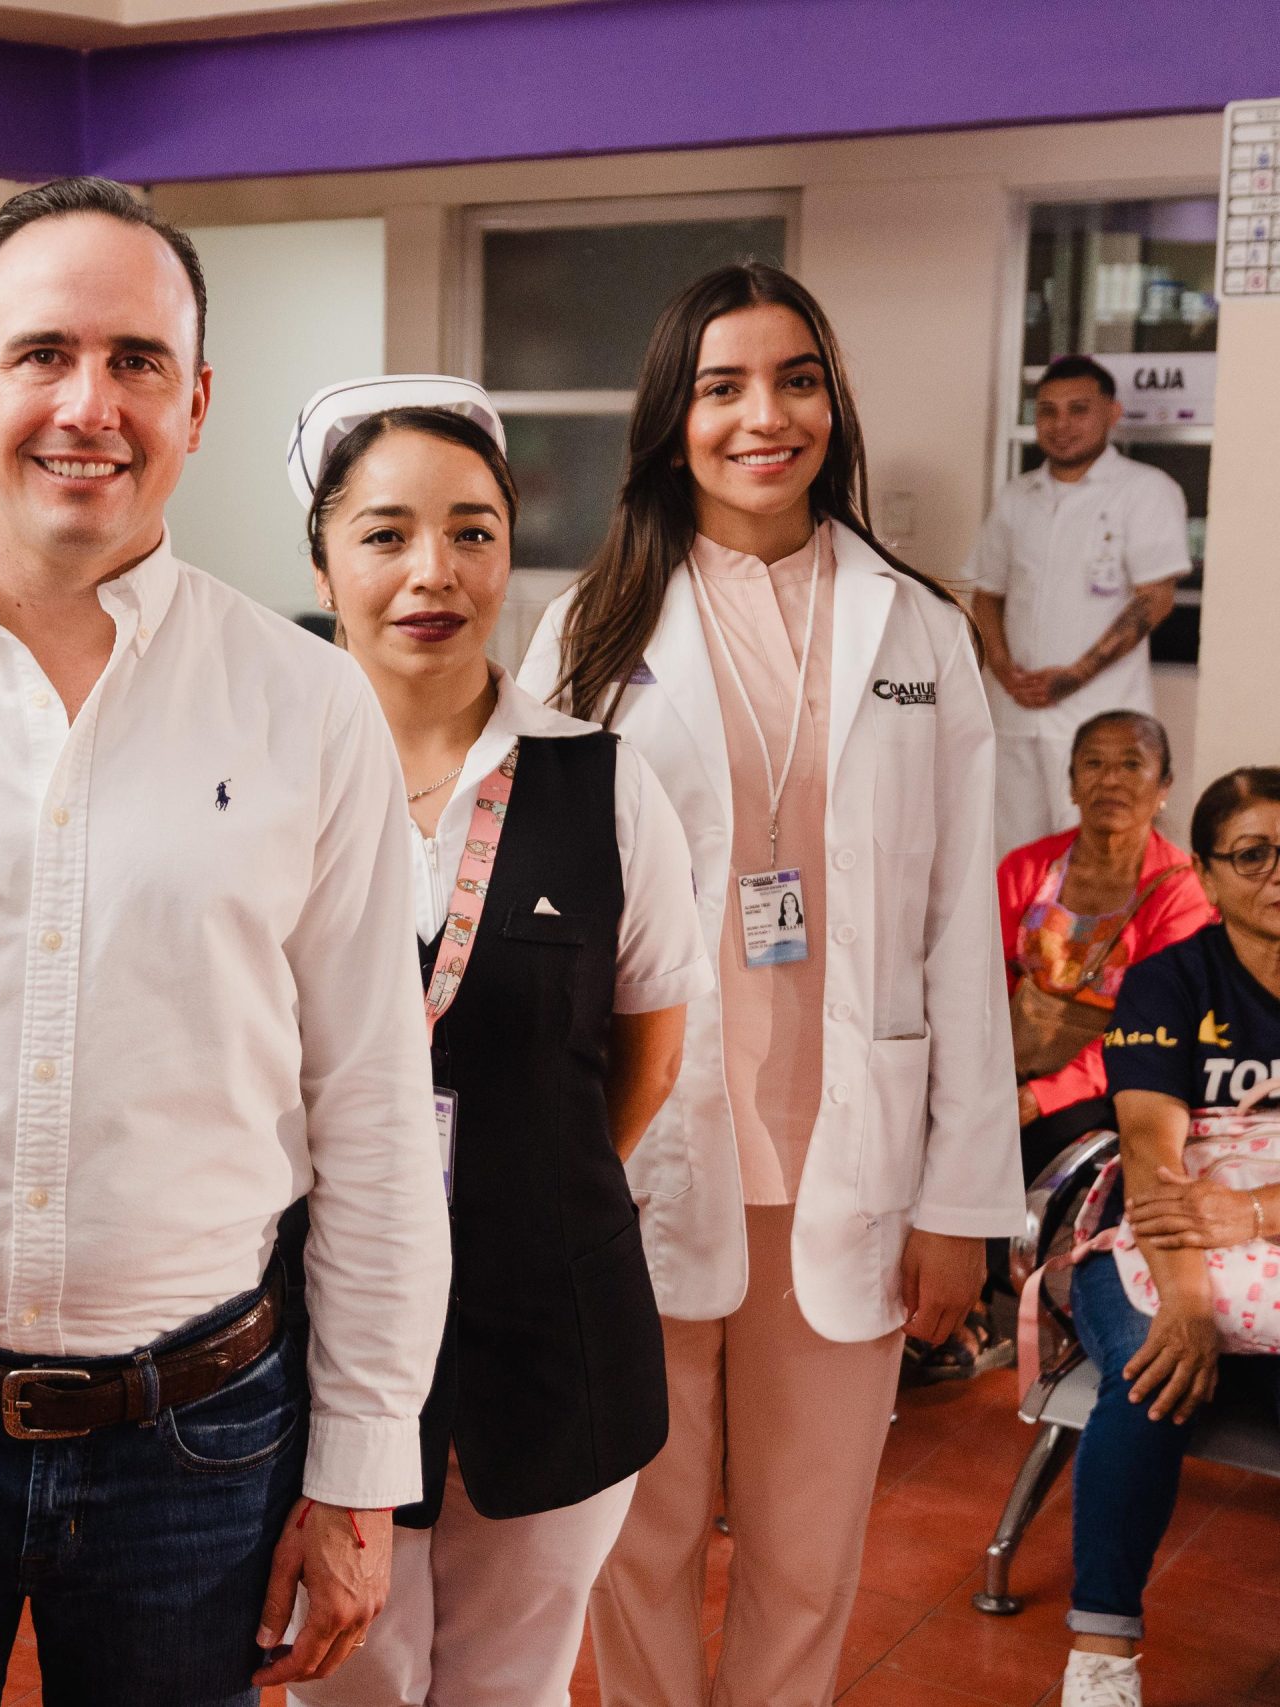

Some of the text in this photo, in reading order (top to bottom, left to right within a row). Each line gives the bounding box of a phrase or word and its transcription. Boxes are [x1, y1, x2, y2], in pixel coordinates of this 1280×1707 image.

[1133, 367, 1185, 390] CAJA
[740, 875, 777, 887] COAHUILA
[1204, 1058, 1280, 1104] TO
